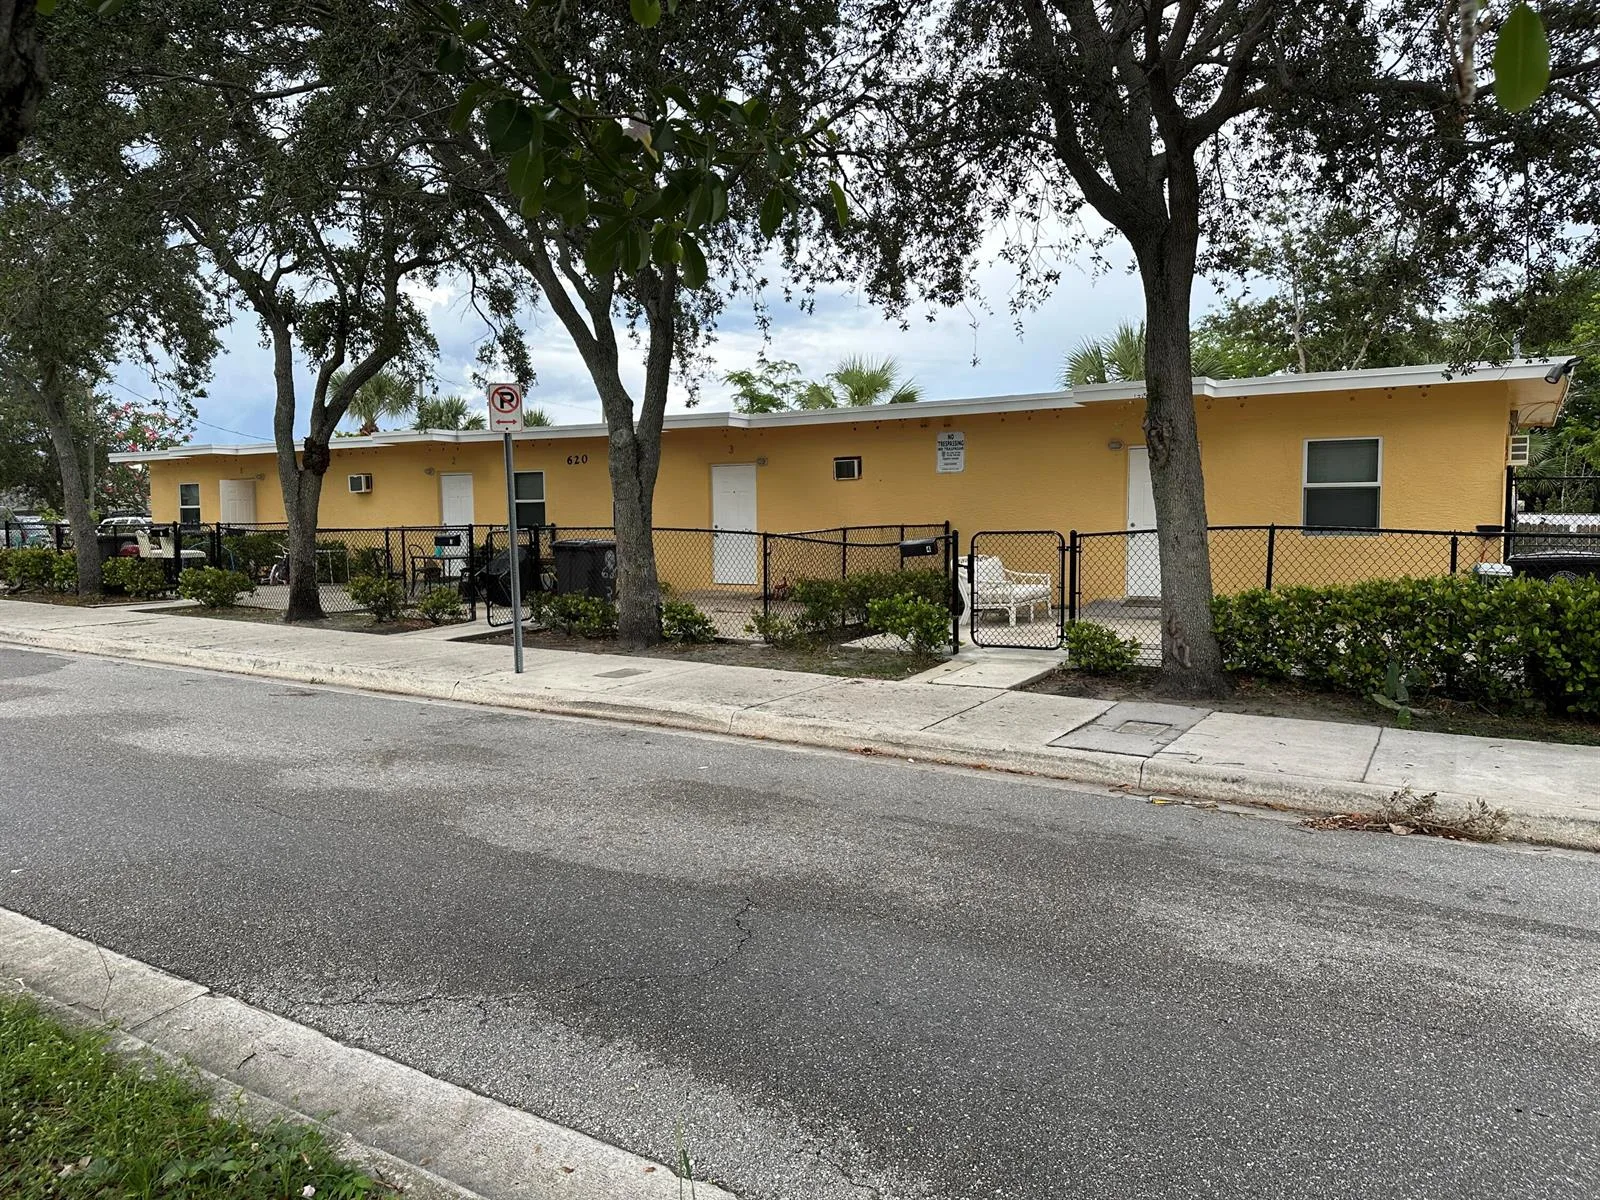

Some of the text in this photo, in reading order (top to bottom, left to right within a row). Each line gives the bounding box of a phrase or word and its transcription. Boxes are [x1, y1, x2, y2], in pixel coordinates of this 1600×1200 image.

[499, 392, 514, 409] P
[728, 444, 734, 454] 3
[566, 454, 588, 465] 620
